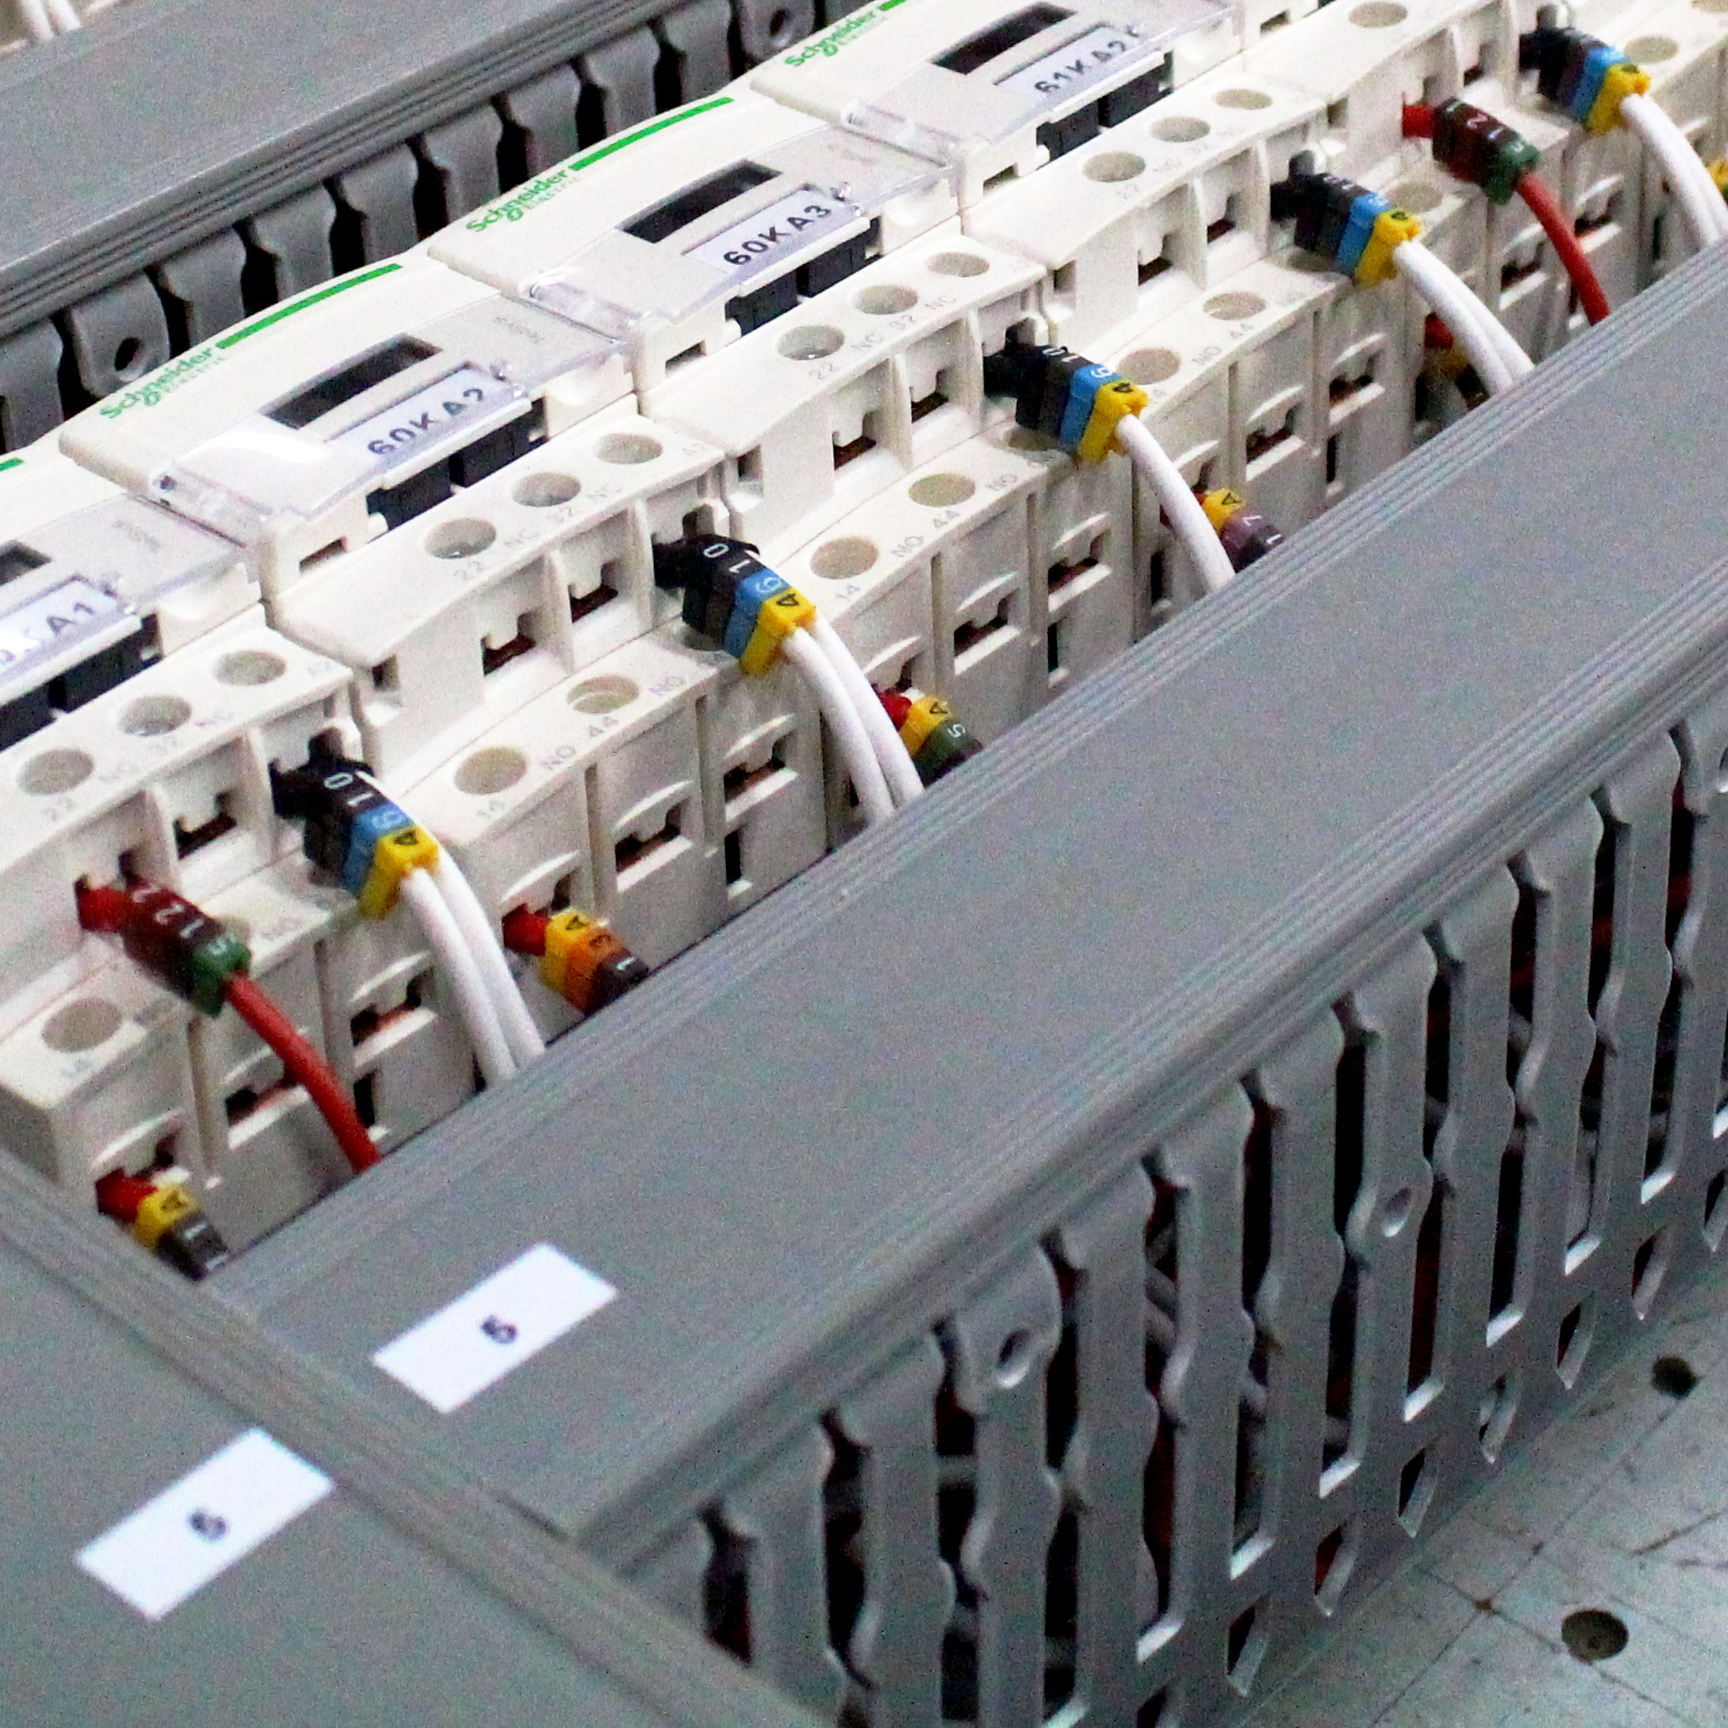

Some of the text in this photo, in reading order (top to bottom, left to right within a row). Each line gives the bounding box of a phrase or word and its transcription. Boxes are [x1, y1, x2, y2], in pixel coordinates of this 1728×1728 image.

[466, 169, 569, 232] Schneider
[722, 202, 833, 268] 60KA3
[99, 346, 216, 420] Schneider
